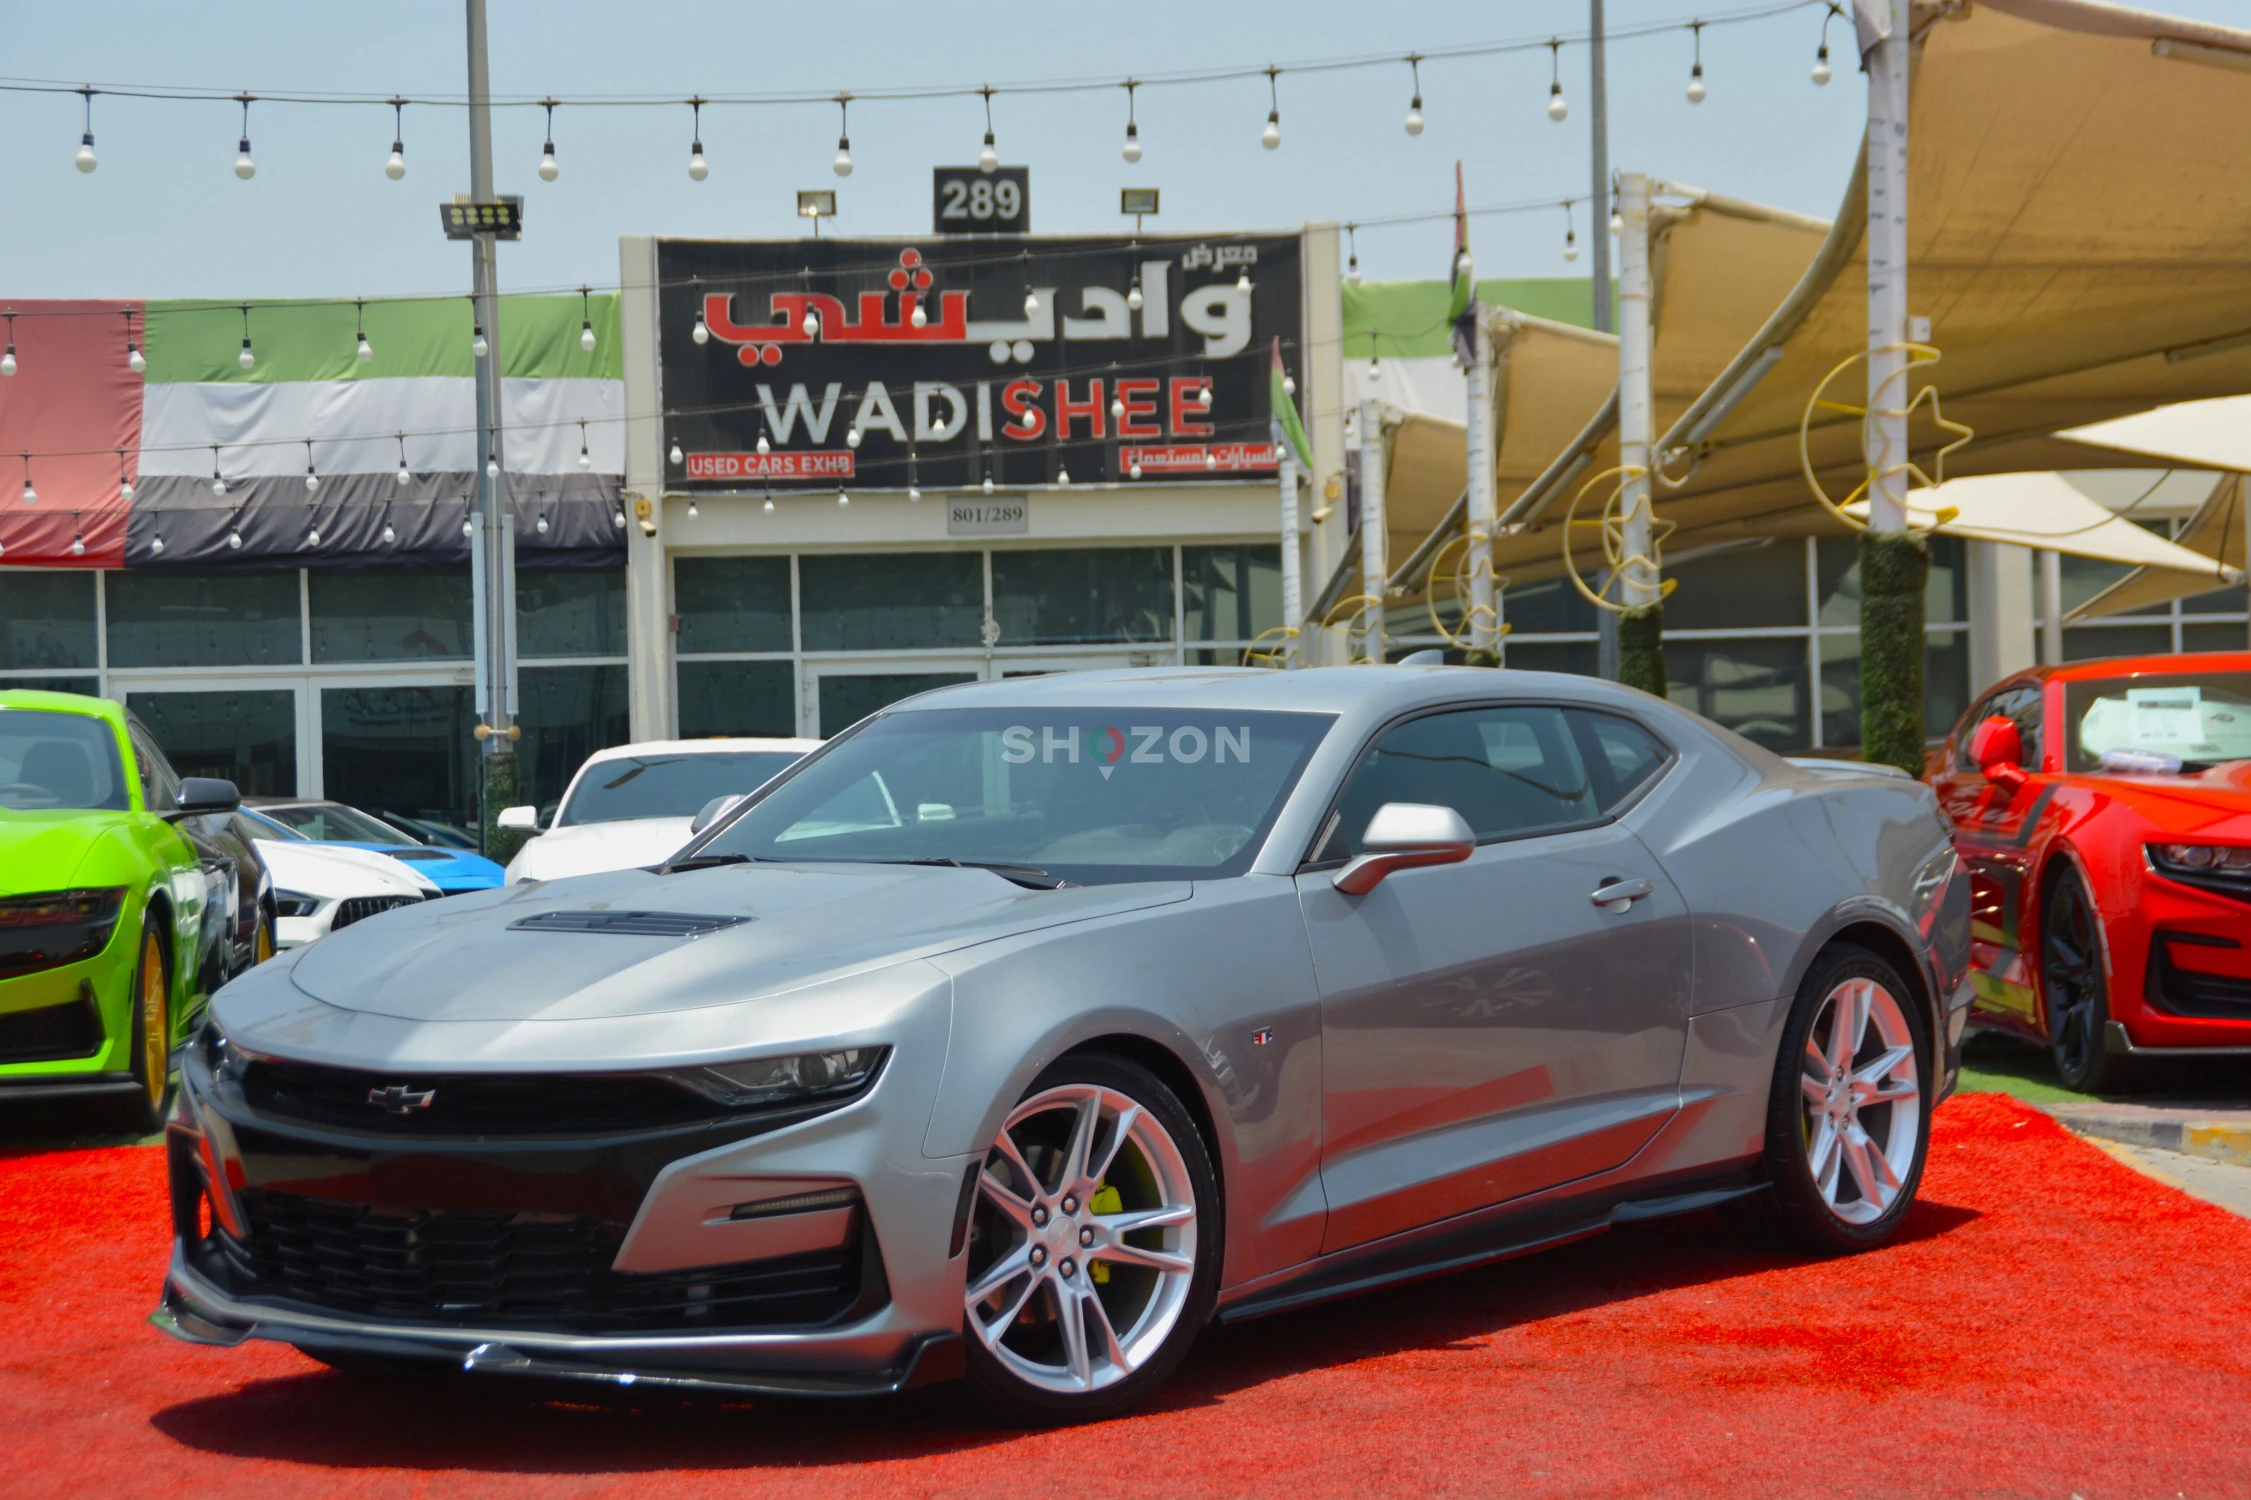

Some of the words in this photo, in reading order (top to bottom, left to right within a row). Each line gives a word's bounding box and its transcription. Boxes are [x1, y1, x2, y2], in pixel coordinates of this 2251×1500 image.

[942, 179, 1021, 220] 289
[1182, 243, 1258, 274] معرض
[754, 376, 1215, 443] WADISHEE
[690, 457, 739, 475] USED
[744, 456, 795, 474] CARS
[953, 506, 1023, 523] 801/289
